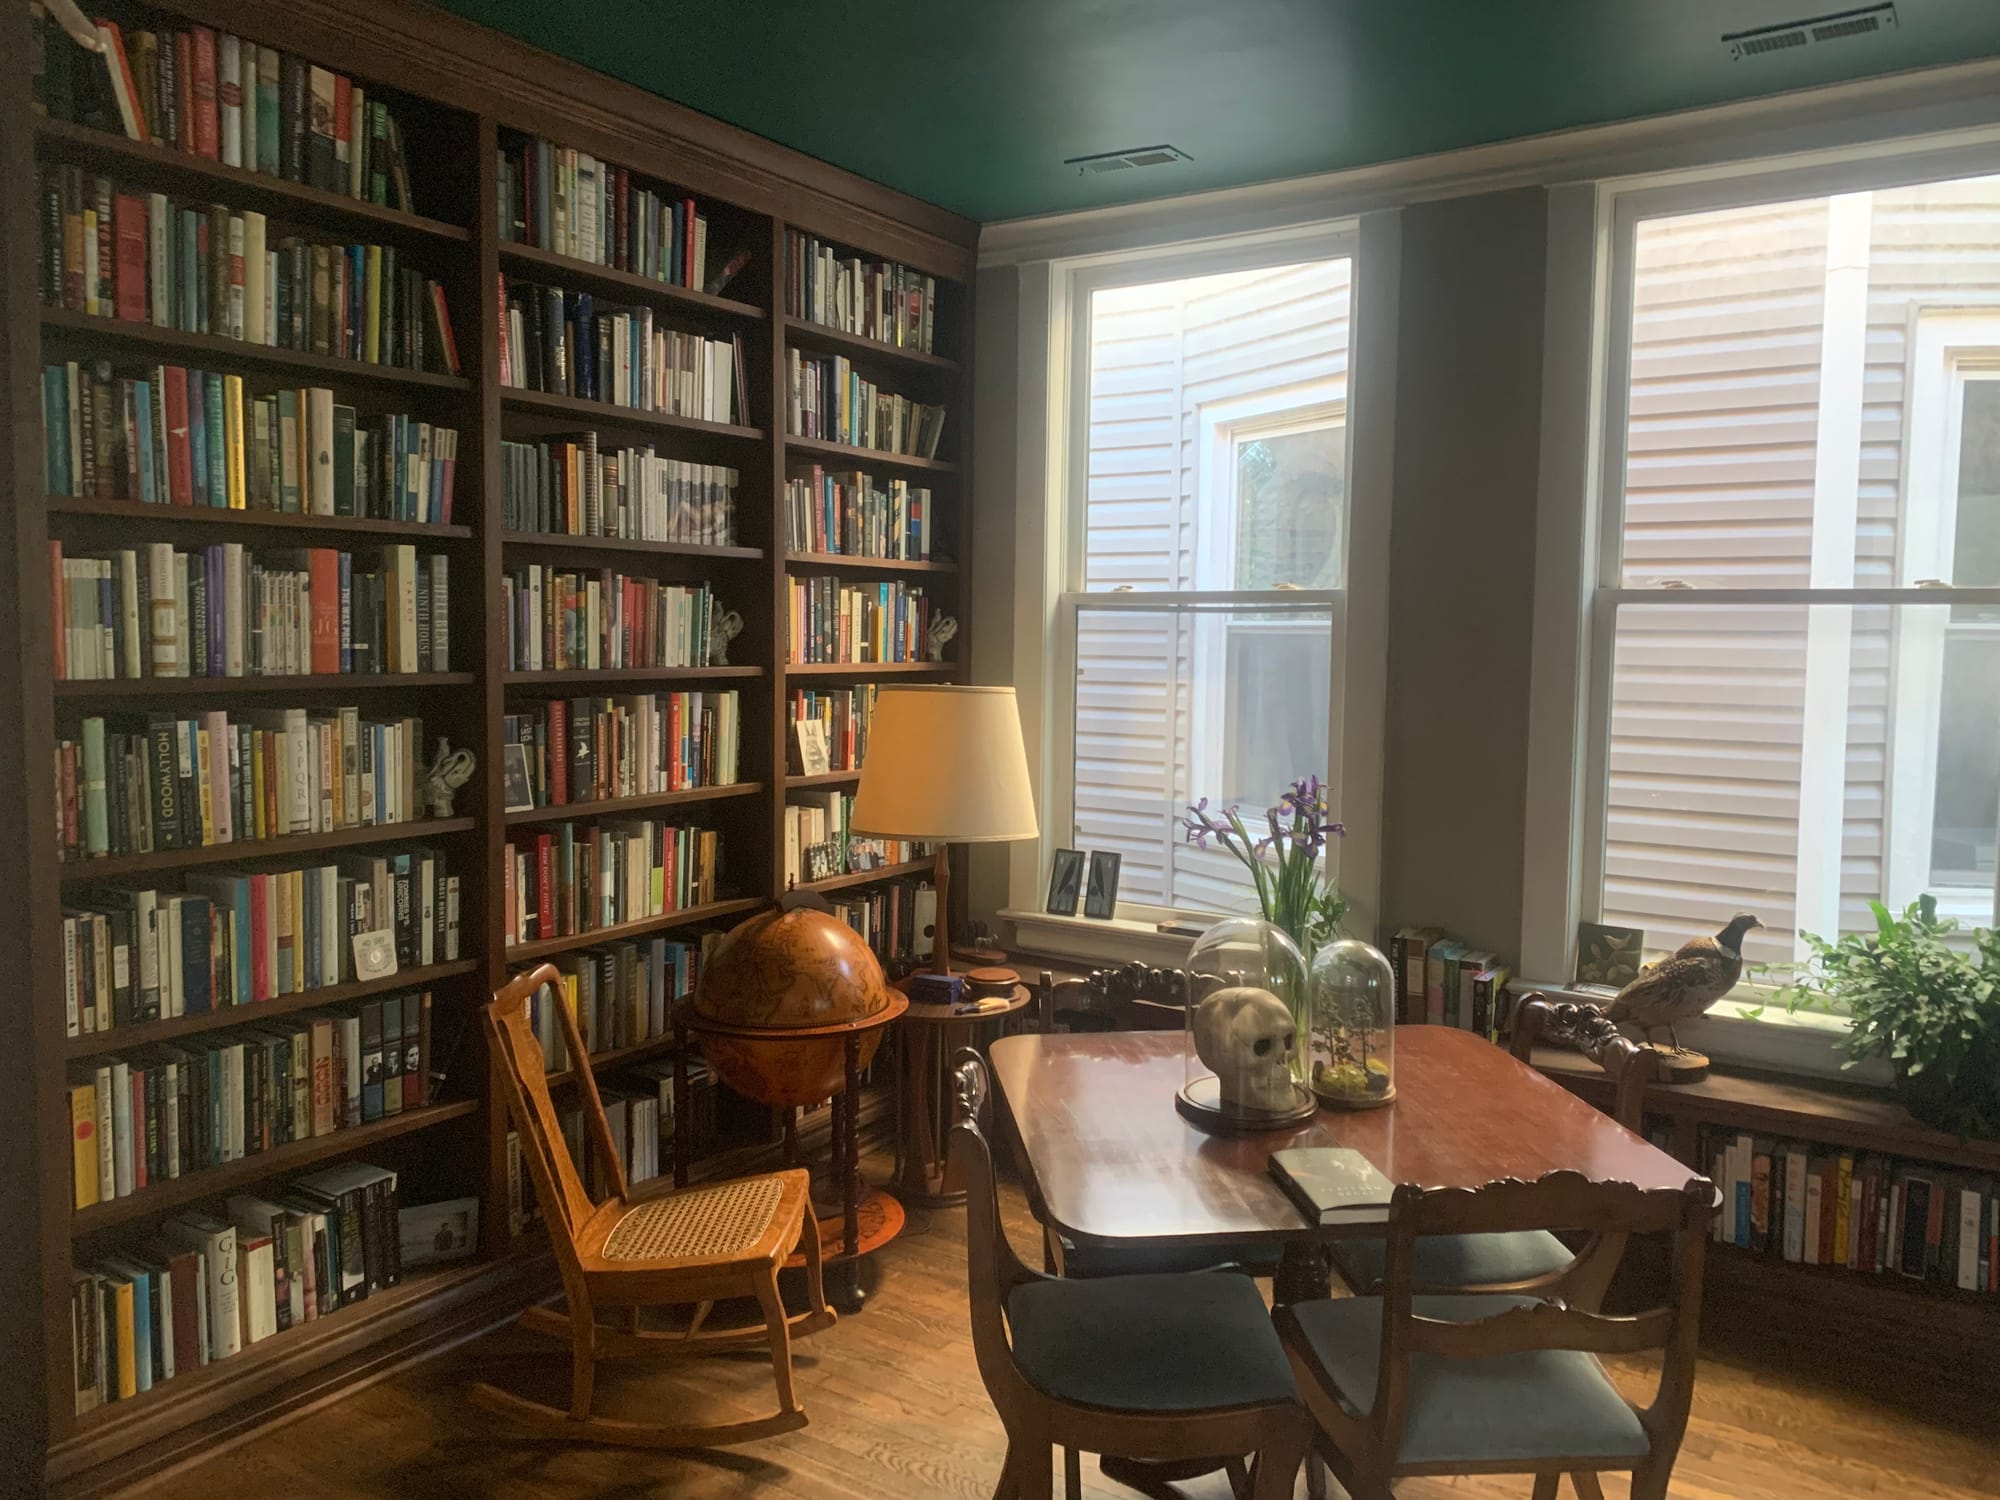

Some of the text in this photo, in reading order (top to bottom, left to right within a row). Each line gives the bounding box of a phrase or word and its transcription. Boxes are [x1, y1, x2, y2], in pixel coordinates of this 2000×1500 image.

[99, 246, 111, 279] VICE
[82, 388, 94, 476] ANDRE GIANT
[341, 588, 351, 649] THE WAX PACK
[418, 588, 429, 656] NINTH HOUSE
[434, 584, 449, 650] HELL BENT
[520, 727, 532, 735] LAST
[520, 734, 533, 742] LION
[158, 732, 173, 818] HOLLYWOOD
[296, 740, 306, 800] SPQR
[1391, 943, 1399, 958] THE
[219, 1235, 234, 1287] GIG
